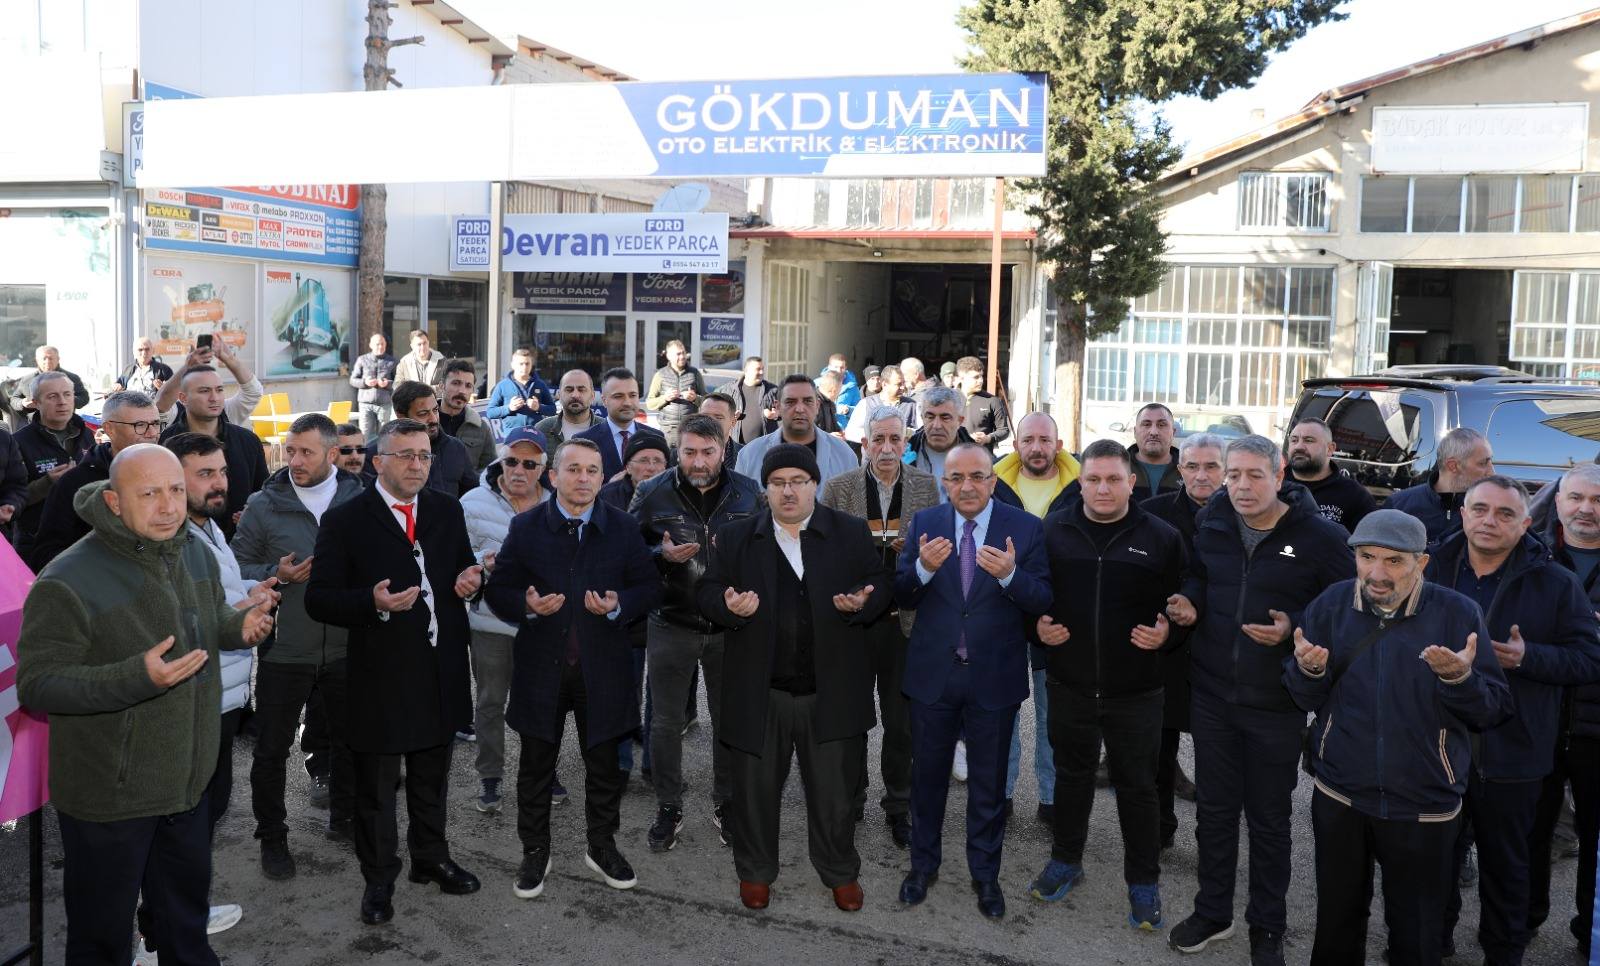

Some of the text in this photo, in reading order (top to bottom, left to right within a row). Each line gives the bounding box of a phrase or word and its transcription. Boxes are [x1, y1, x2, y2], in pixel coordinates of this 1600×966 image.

[656, 85, 1030, 133] GÖKDUMAN
[657, 130, 1027, 154] OTO ELEKTRİK & ELEKTRONİK
[159, 191, 184, 201] BOSCH
[261, 207, 288, 217] metabo
[289, 210, 324, 223] PROXXON
[262, 220, 278, 231] MAX
[458, 221, 489, 234] FORD
[646, 220, 682, 231] FORD
[460, 237, 487, 245] YEDEK
[502, 227, 609, 256] Devran
[615, 235, 719, 252] YEDEK PARÇA
[460, 246, 487, 255] PARÇA
[642, 273, 688, 290] Ford
[525, 287, 610, 297] YEDEK PARÇA
[707, 319, 737, 332] Ford
